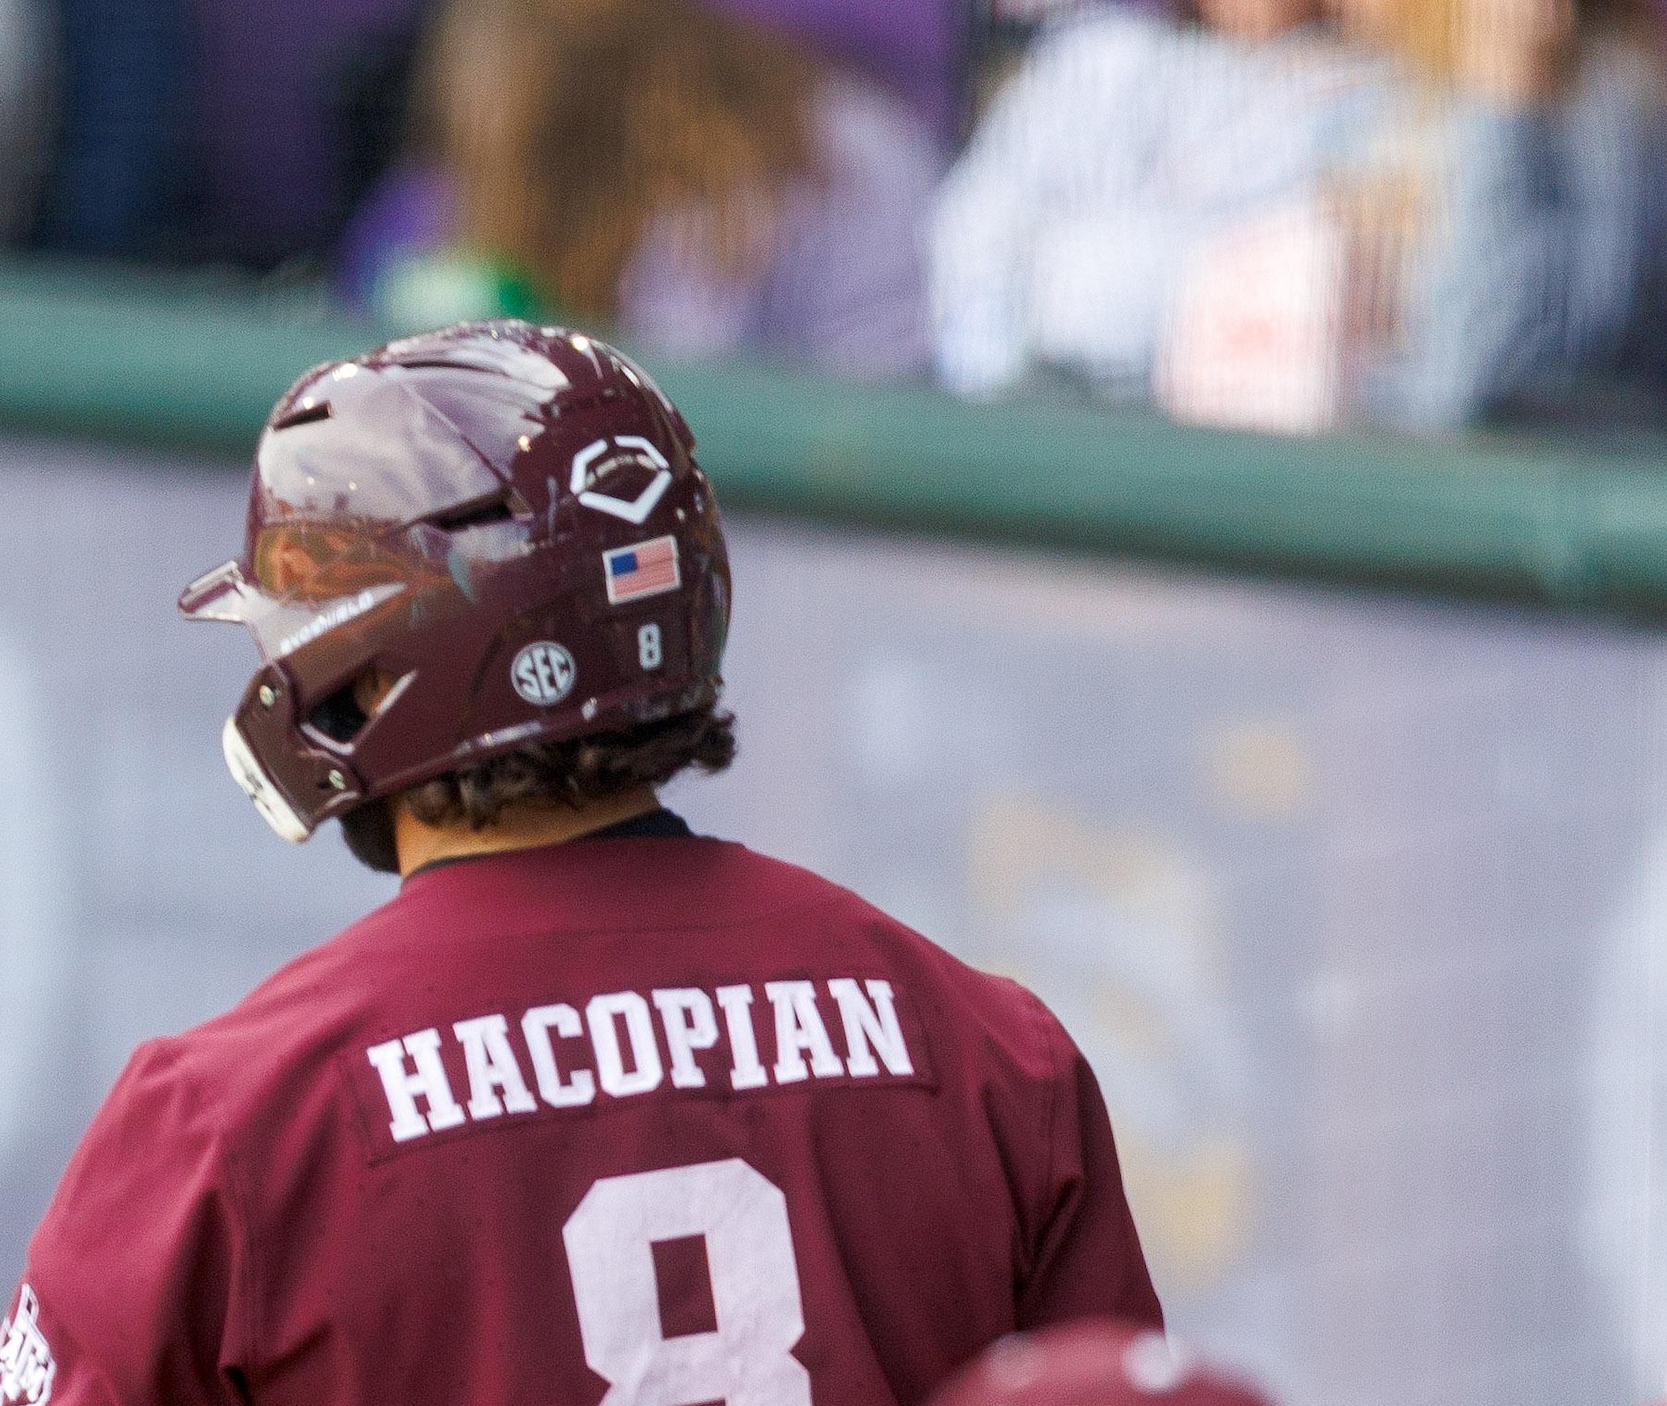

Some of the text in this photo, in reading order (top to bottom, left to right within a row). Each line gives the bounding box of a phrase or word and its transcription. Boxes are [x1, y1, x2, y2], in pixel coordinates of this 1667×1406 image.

[637, 623, 662, 670] 8
[517, 647, 573, 700] SEC
[367, 977, 916, 1143] HACOPIAN
